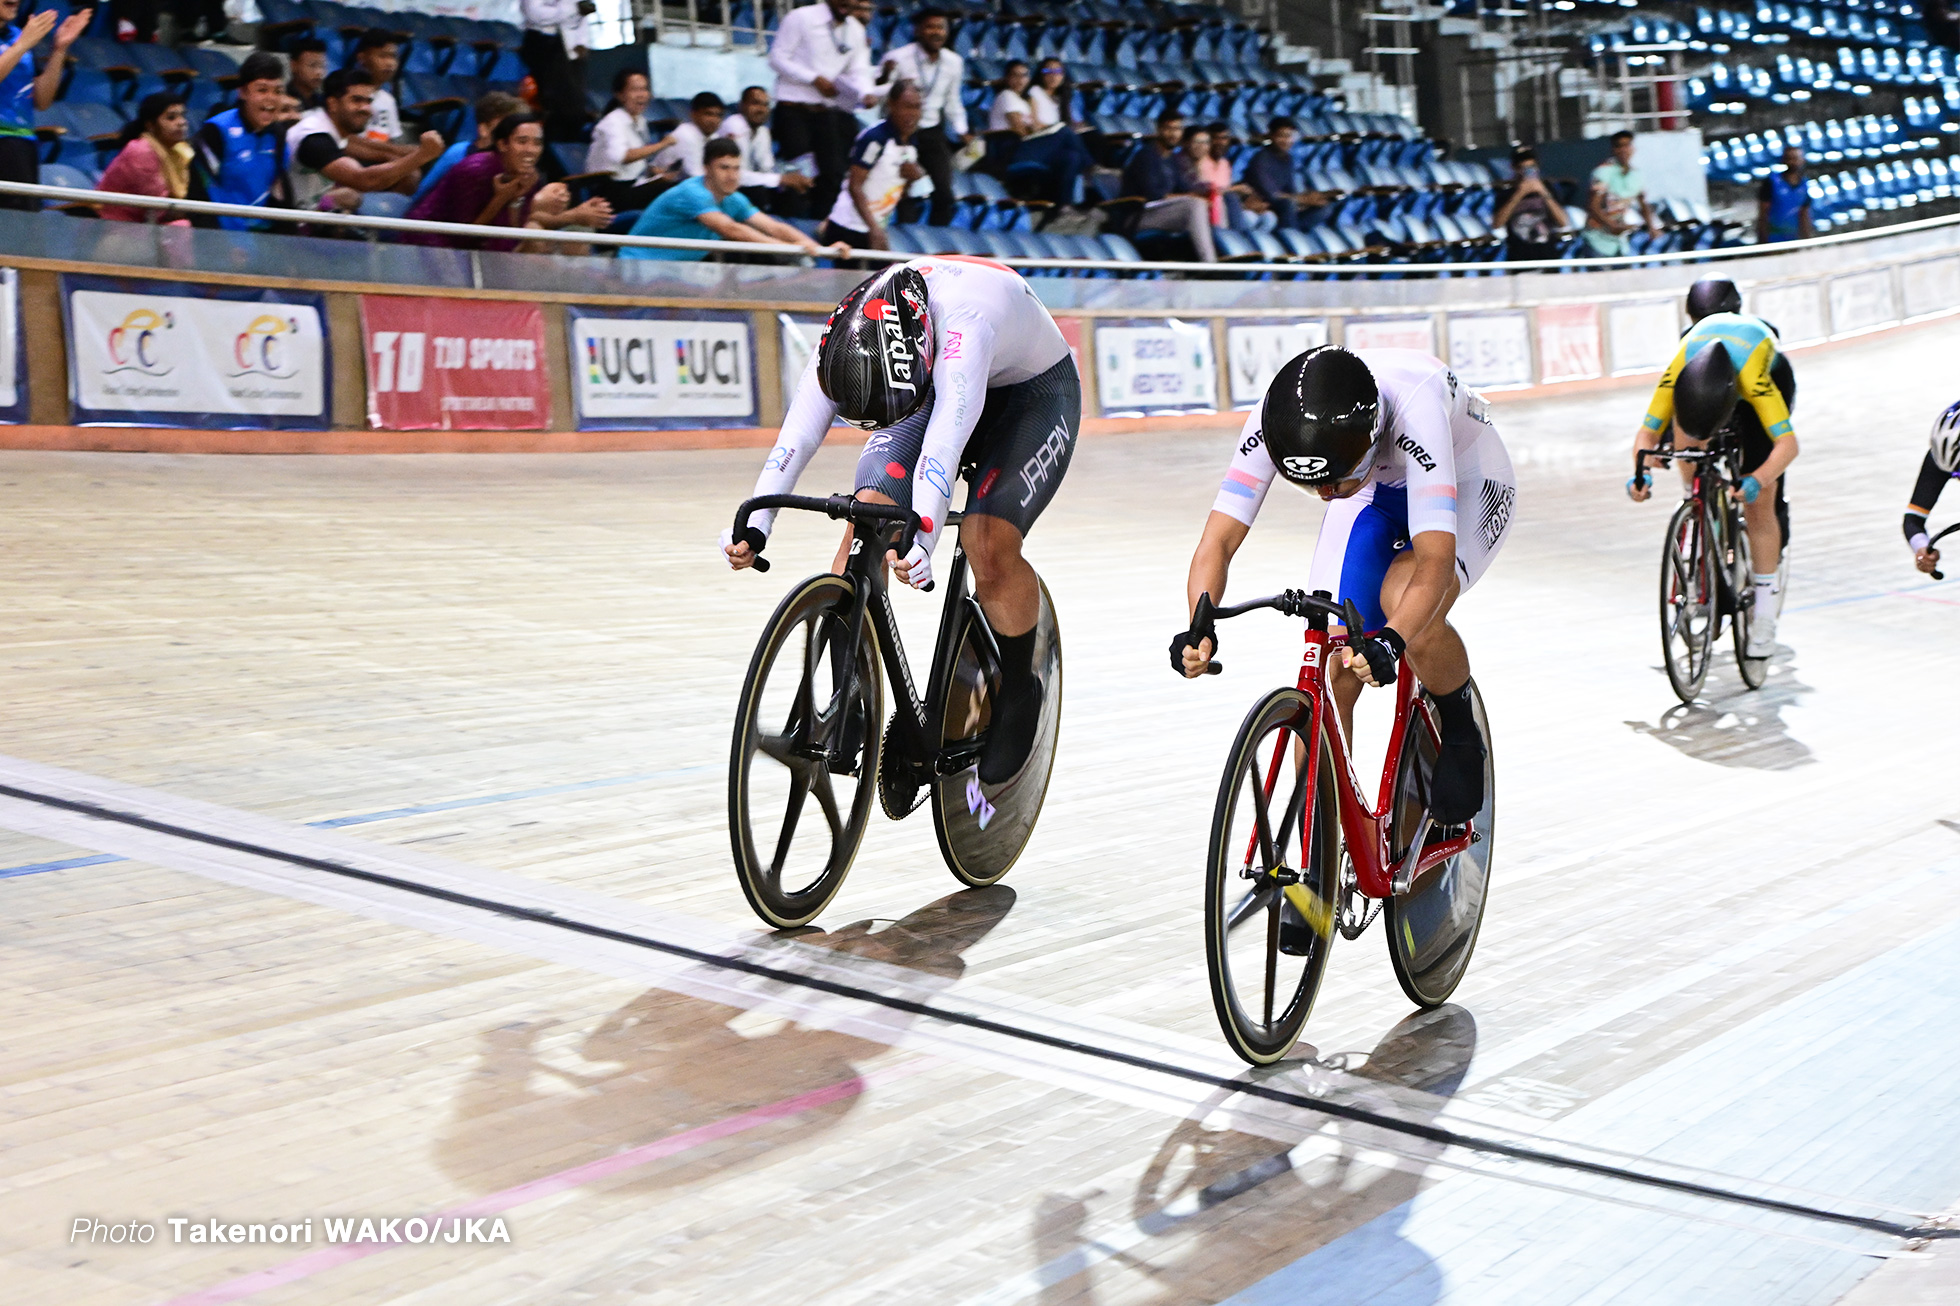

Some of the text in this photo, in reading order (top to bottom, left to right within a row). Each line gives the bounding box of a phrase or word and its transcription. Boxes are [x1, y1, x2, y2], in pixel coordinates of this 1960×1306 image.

[373, 331, 426, 393] 10
[601, 337, 657, 384] UCI
[688, 339, 741, 384] UCI
[877, 304, 917, 397] Japan
[778, 447, 796, 473] KEIRIN
[918, 454, 928, 481] KEIRIN
[1019, 414, 1071, 508] JAPAN
[1395, 433, 1437, 472] KOREA
[881, 590, 928, 728] BRIDGESTONE
[1303, 646, 1317, 662] é
